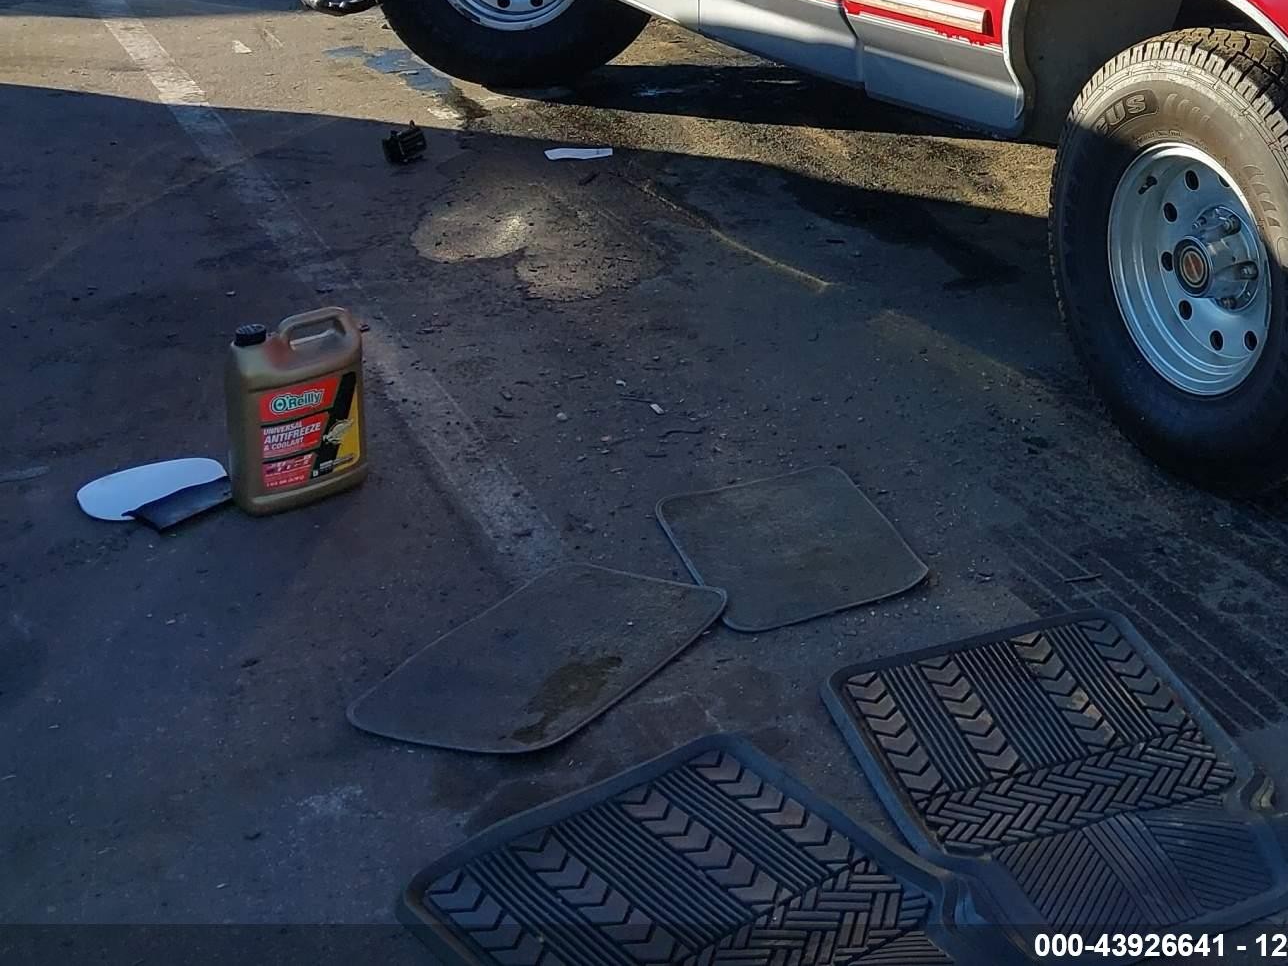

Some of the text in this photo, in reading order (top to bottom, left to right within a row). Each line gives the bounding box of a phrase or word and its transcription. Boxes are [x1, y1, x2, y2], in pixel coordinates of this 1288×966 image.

[271, 390, 322, 413] O'Reilly
[263, 420, 304, 436] UNIVERSAL
[263, 422, 321, 445] ANTIFREEZE
[271, 436, 305, 450] COOLANT
